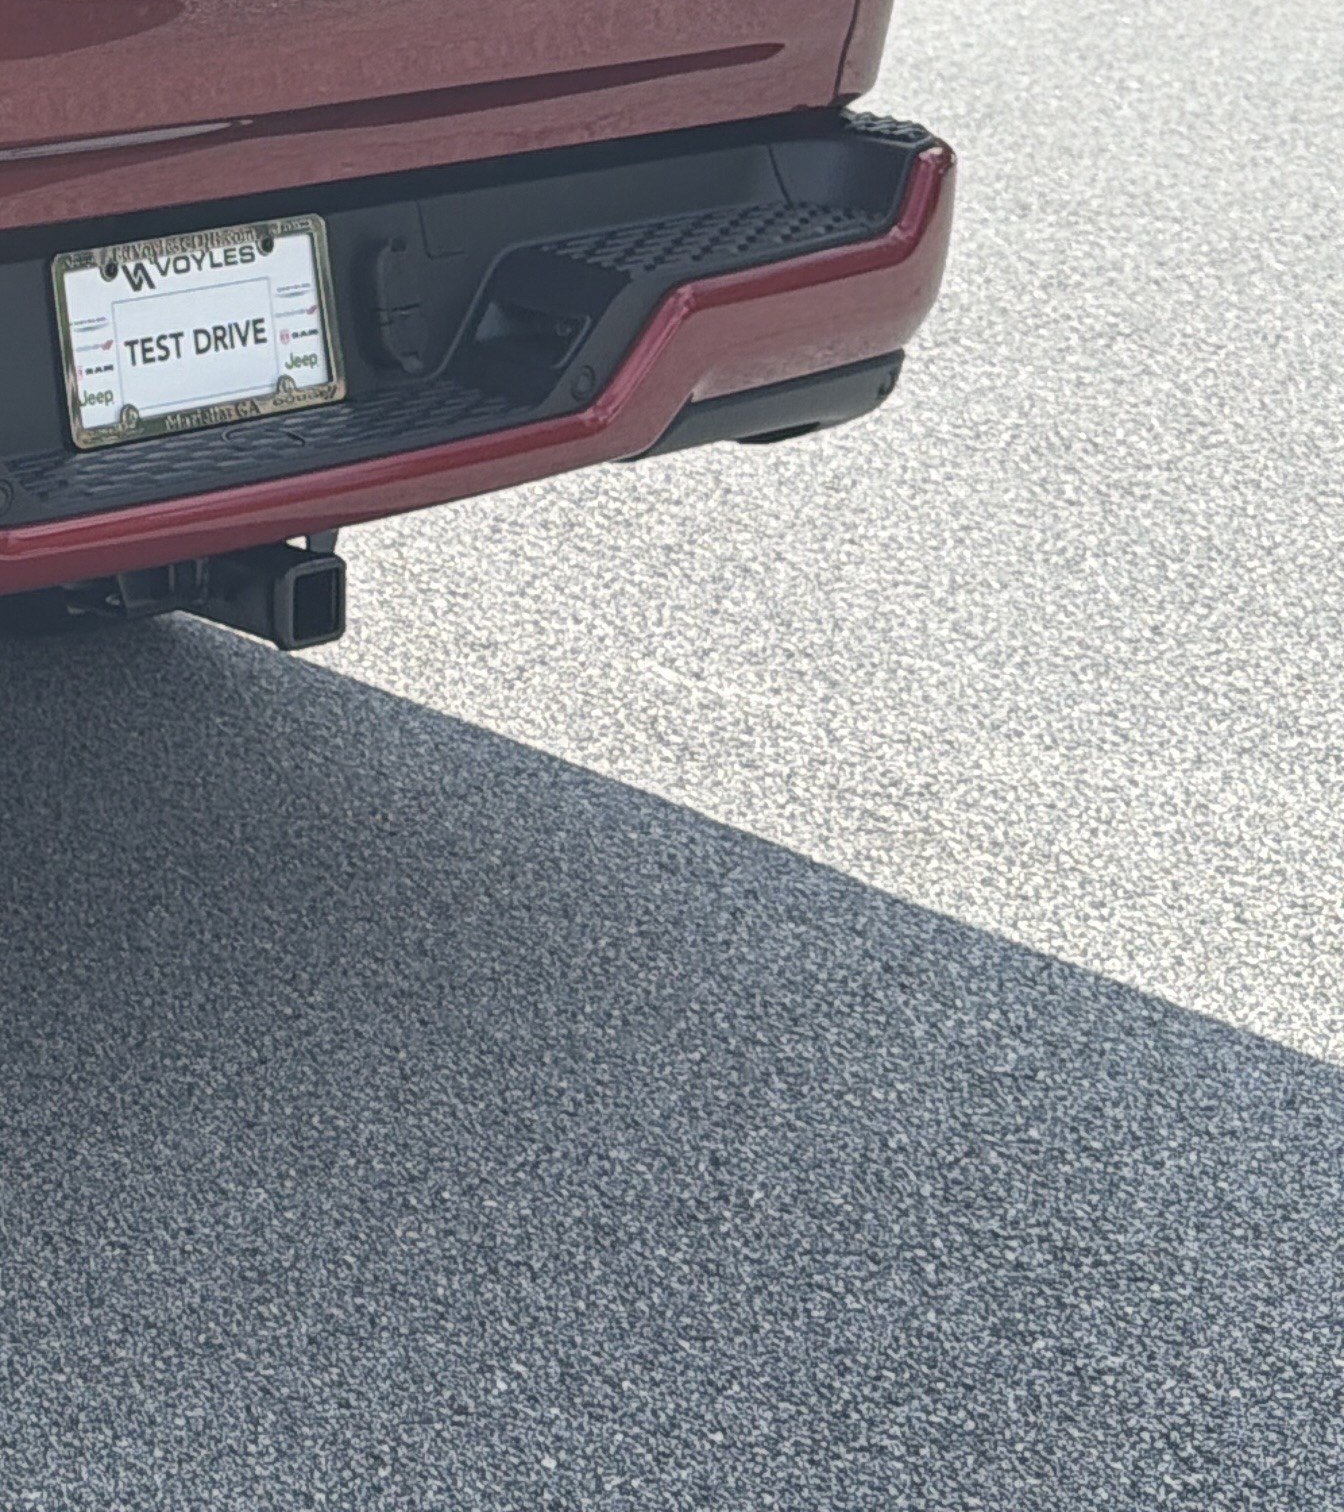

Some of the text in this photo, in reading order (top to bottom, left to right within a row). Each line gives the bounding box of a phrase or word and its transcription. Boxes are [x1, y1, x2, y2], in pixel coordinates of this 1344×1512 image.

[154, 244, 256, 277] VOYLES
[124, 318, 268, 367] TEST DRIVE
[284, 352, 318, 369] Jeep
[79, 389, 114, 407] Jeep
